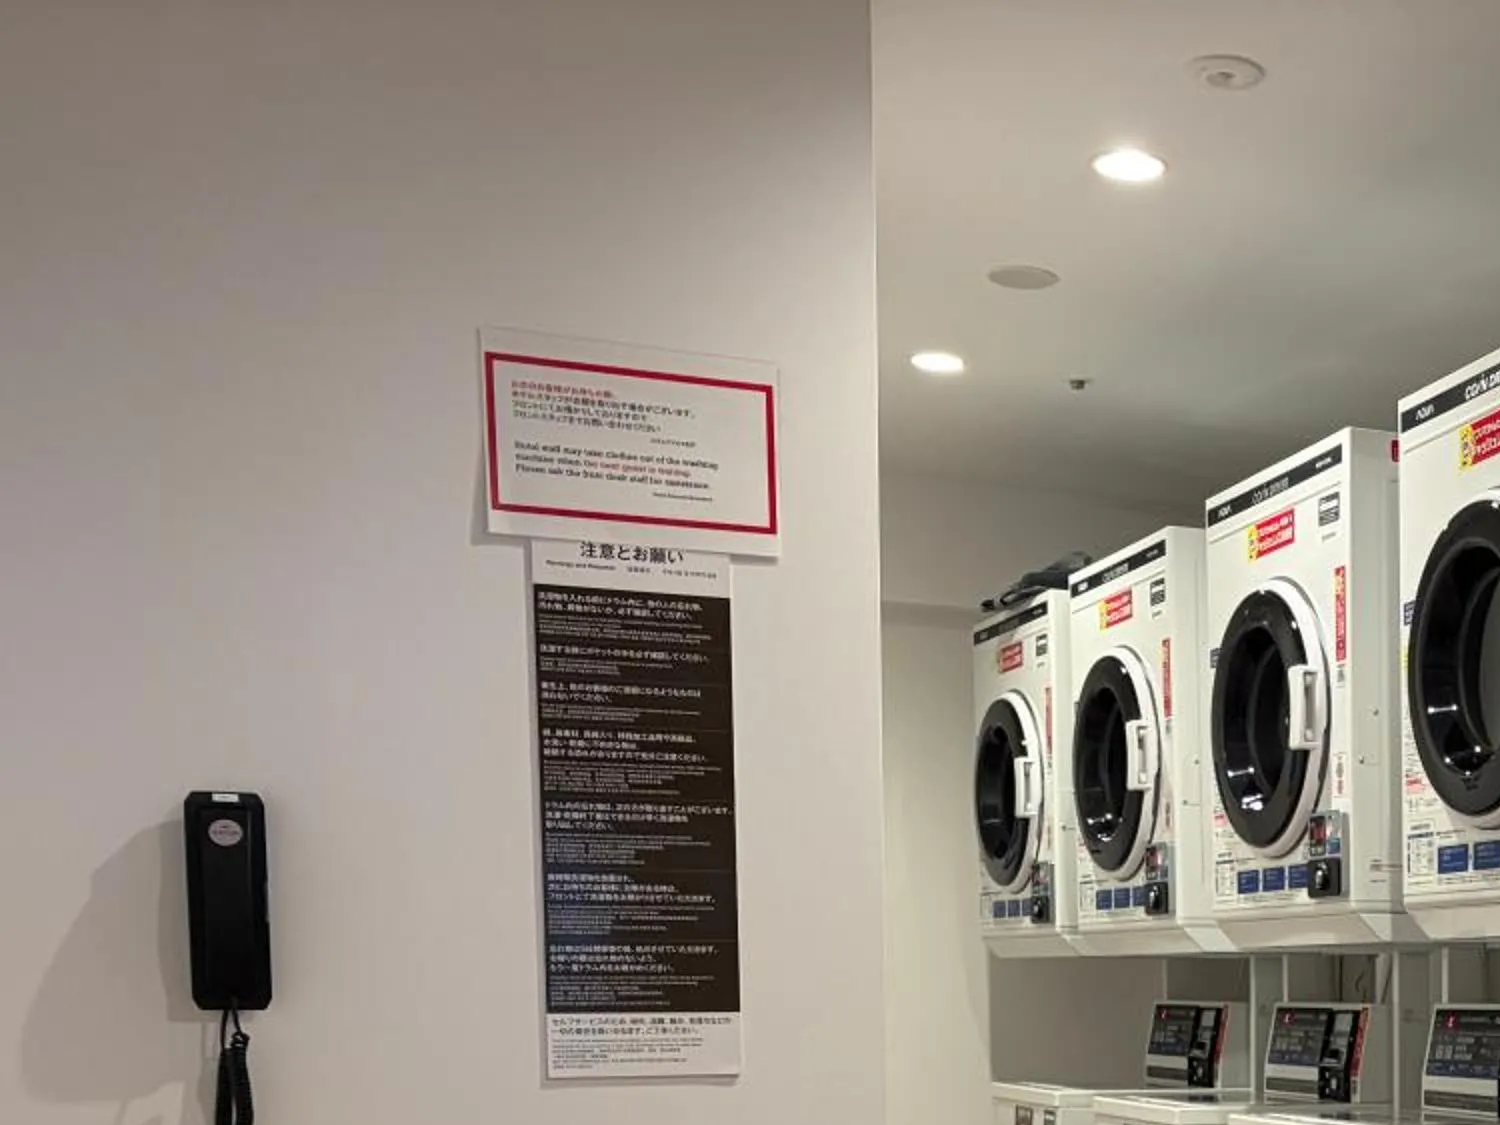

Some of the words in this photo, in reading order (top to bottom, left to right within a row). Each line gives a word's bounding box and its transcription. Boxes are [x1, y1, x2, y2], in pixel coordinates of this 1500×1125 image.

[580, 541, 684, 565] 注意とお願い
